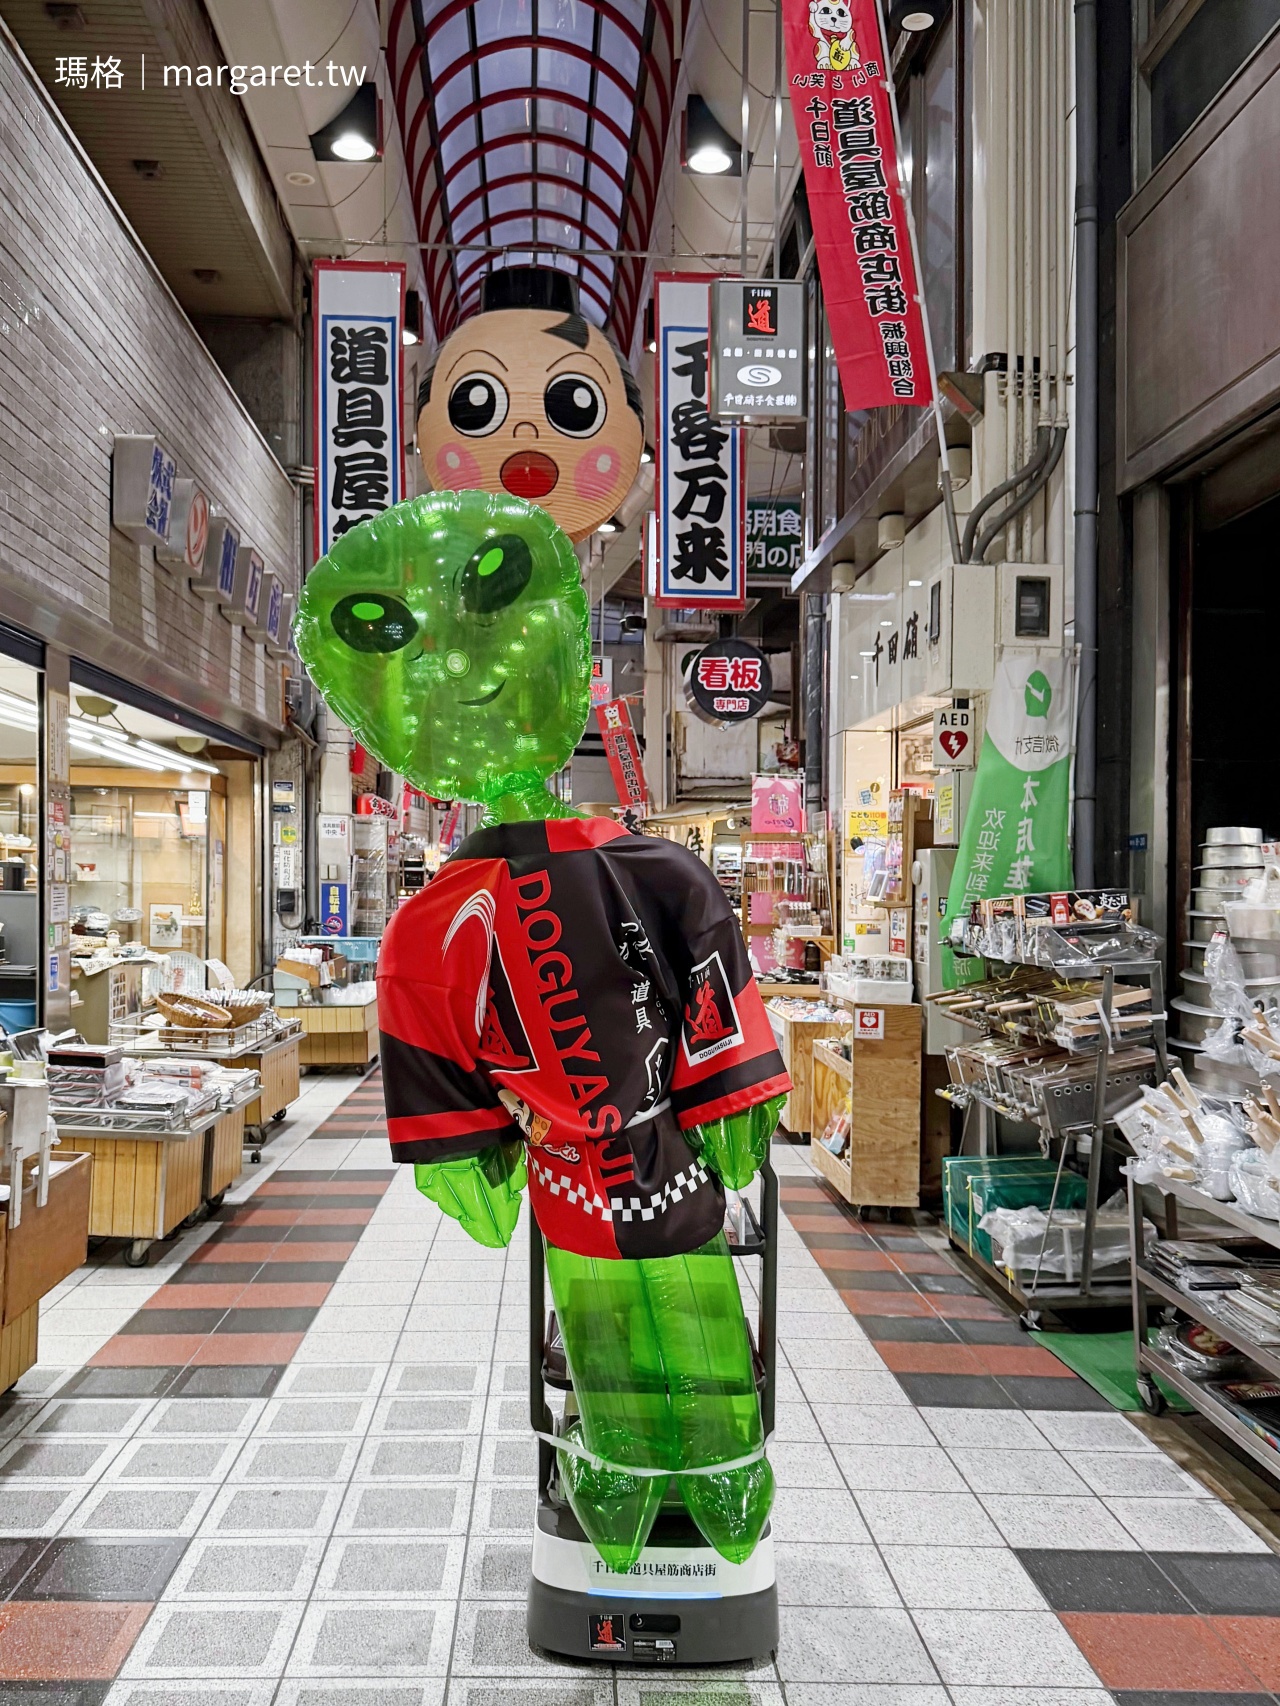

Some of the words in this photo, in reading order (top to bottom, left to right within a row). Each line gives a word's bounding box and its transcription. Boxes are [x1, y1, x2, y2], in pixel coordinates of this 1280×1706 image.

[331, 326, 389, 542] 道具屋
[670, 337, 730, 584] 千客万来
[699, 656, 762, 692] 看板
[713, 697, 750, 713] 専門店
[939, 712, 969, 726] AED
[631, 979, 652, 1034] 道具
[685, 980, 734, 1045] 道
[698, 1038, 733, 1059] DOGUYASUJI
[592, 1560, 717, 1577] 千日道具屋筋商店街
